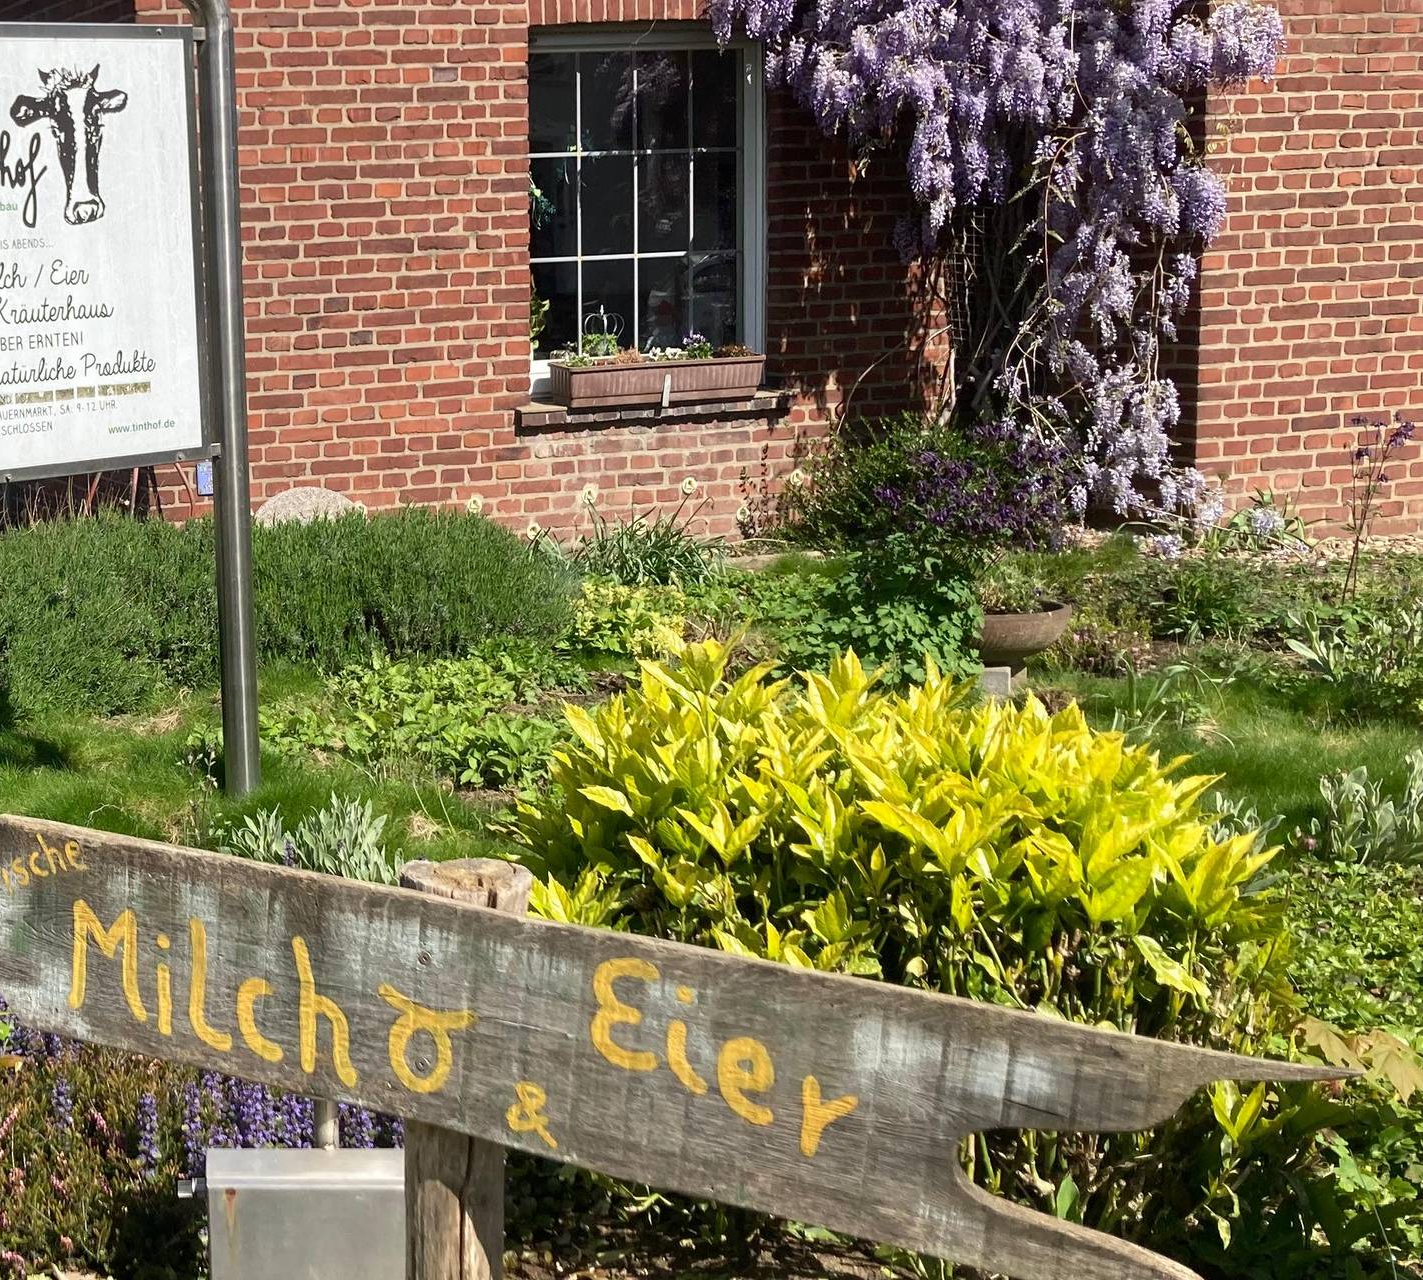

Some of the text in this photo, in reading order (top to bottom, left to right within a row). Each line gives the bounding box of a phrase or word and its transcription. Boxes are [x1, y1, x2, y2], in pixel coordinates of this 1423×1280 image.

[49, 259, 90, 286] Eier
[80, 349, 157, 377] Produkte
[108, 418, 176, 435] www.tinthof.de
[68, 898, 859, 1158] Milch & Eier
